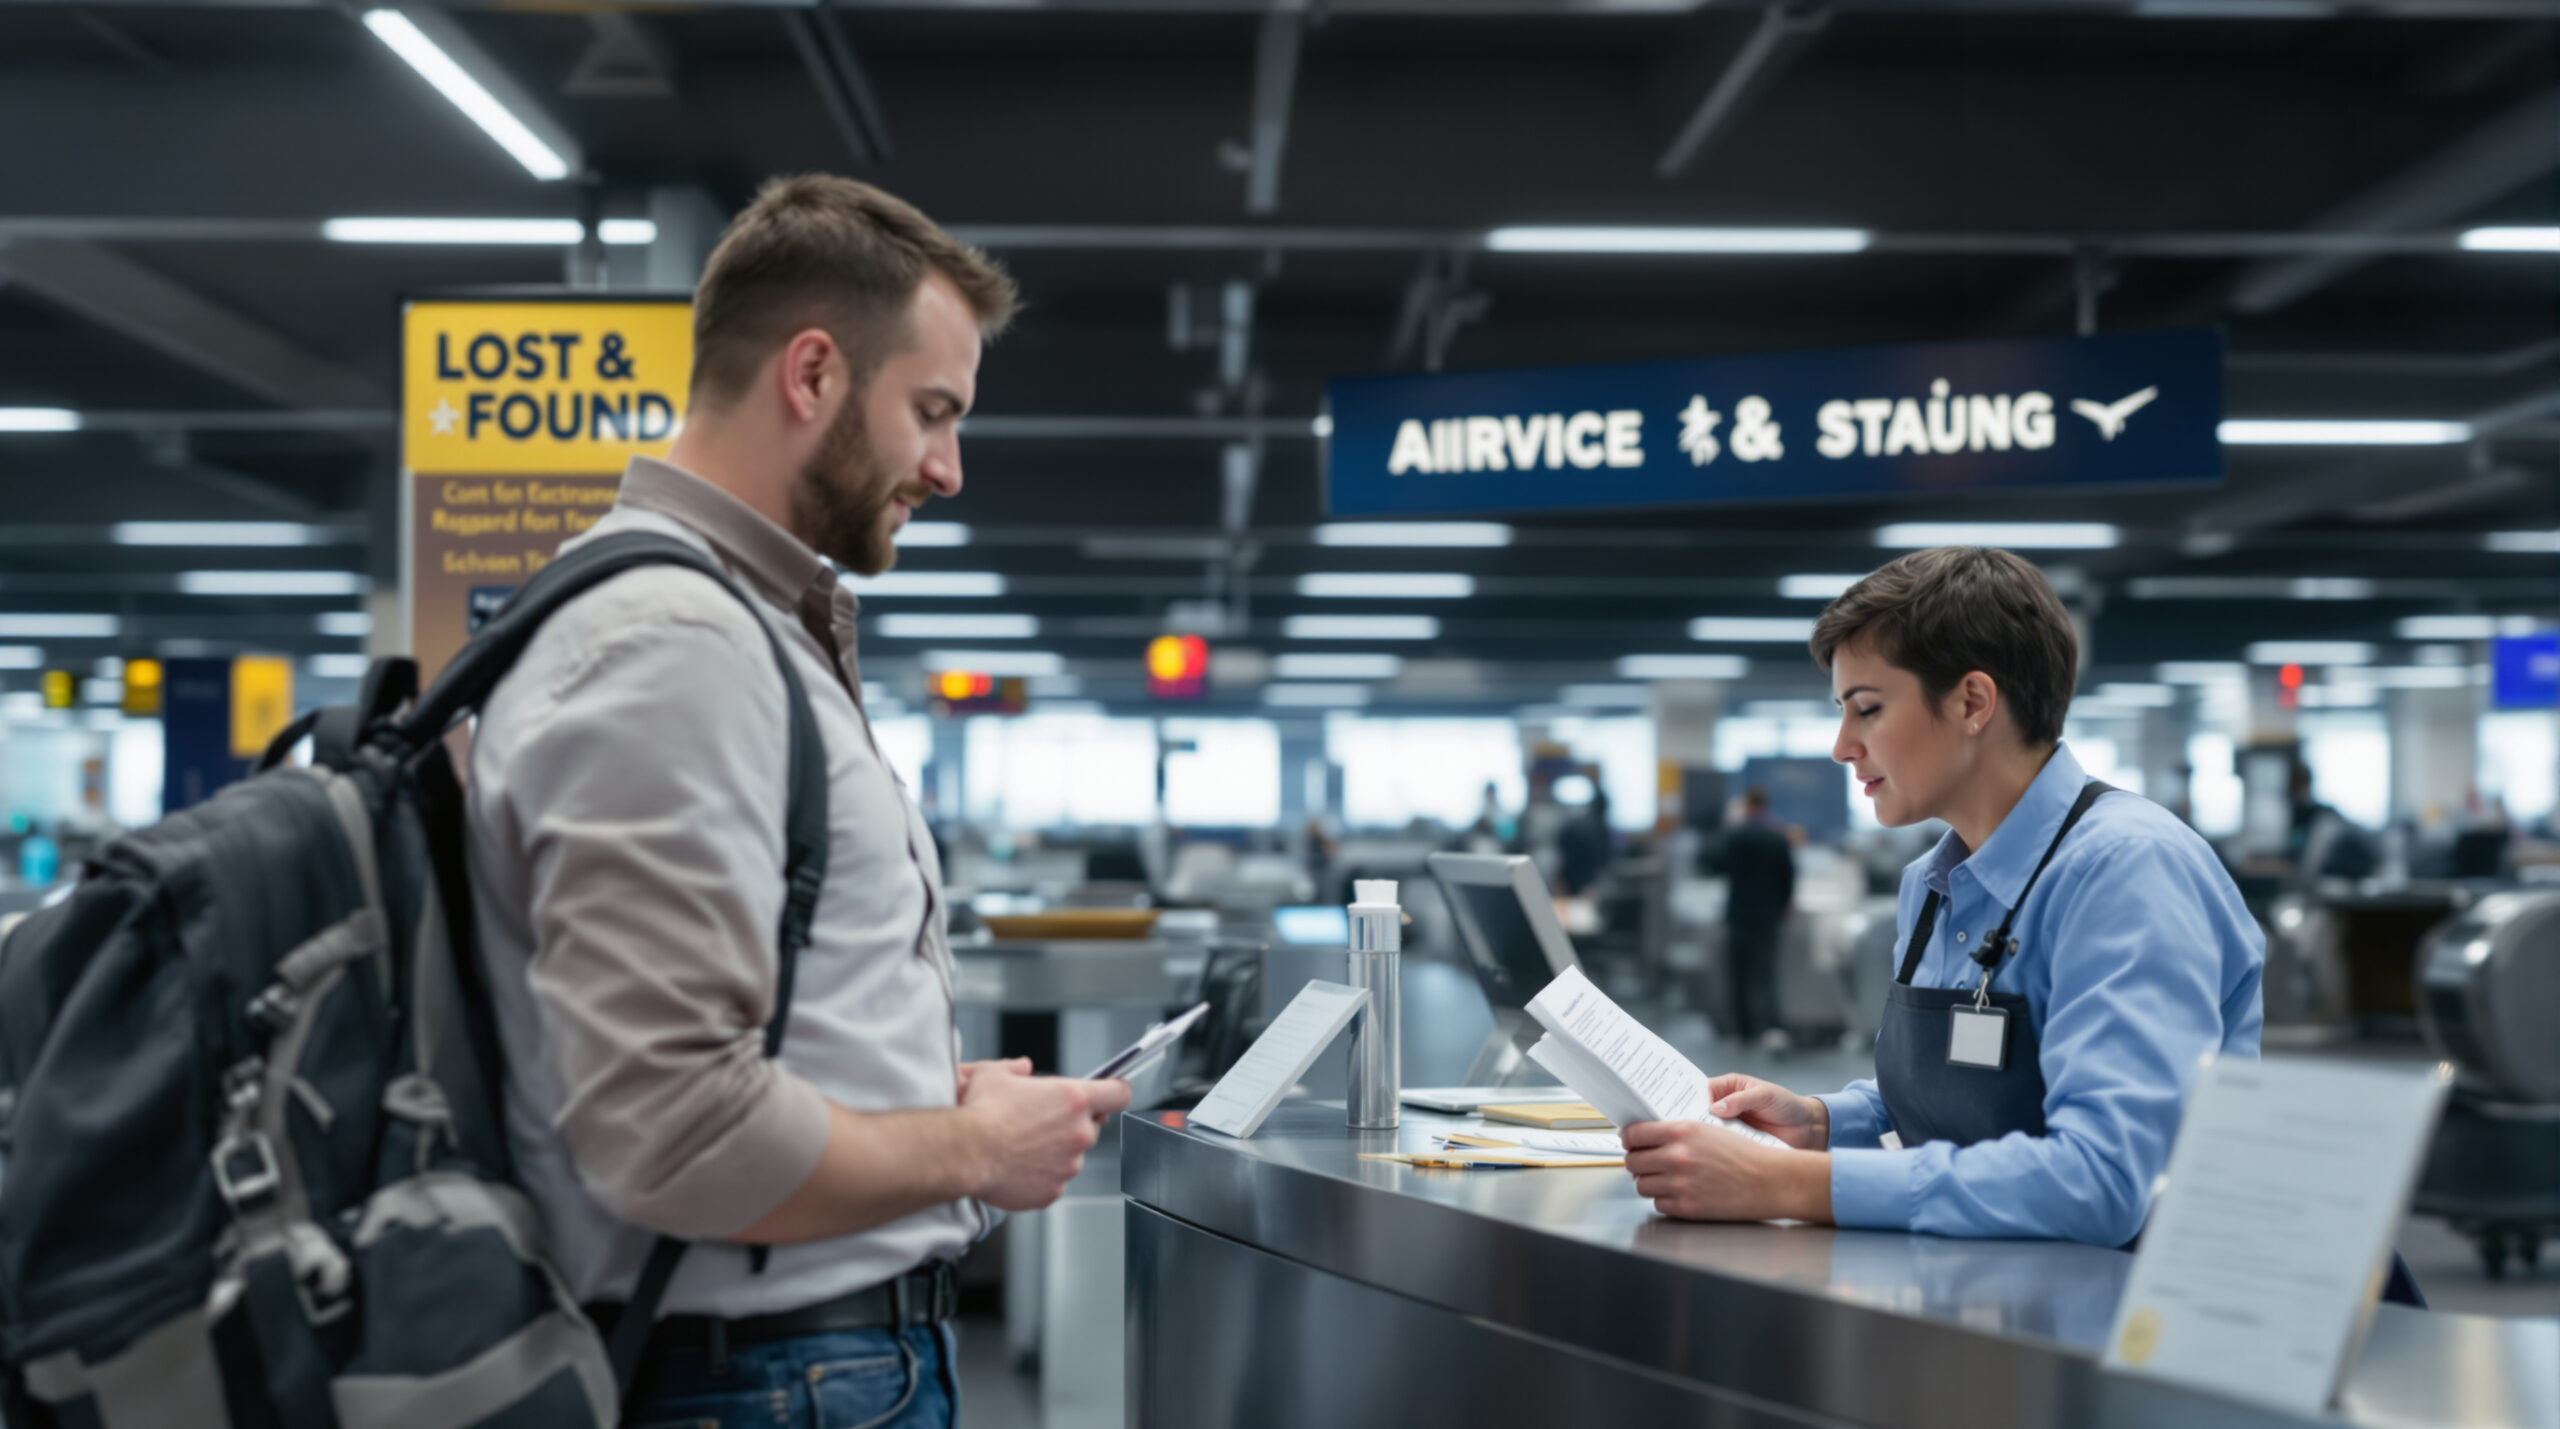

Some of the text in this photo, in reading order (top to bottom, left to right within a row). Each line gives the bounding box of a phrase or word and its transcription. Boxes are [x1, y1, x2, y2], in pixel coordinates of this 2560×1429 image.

[436, 331, 635, 382] LOST &
[466, 391, 675, 442] FOUND
[1729, 395, 1784, 462] &
